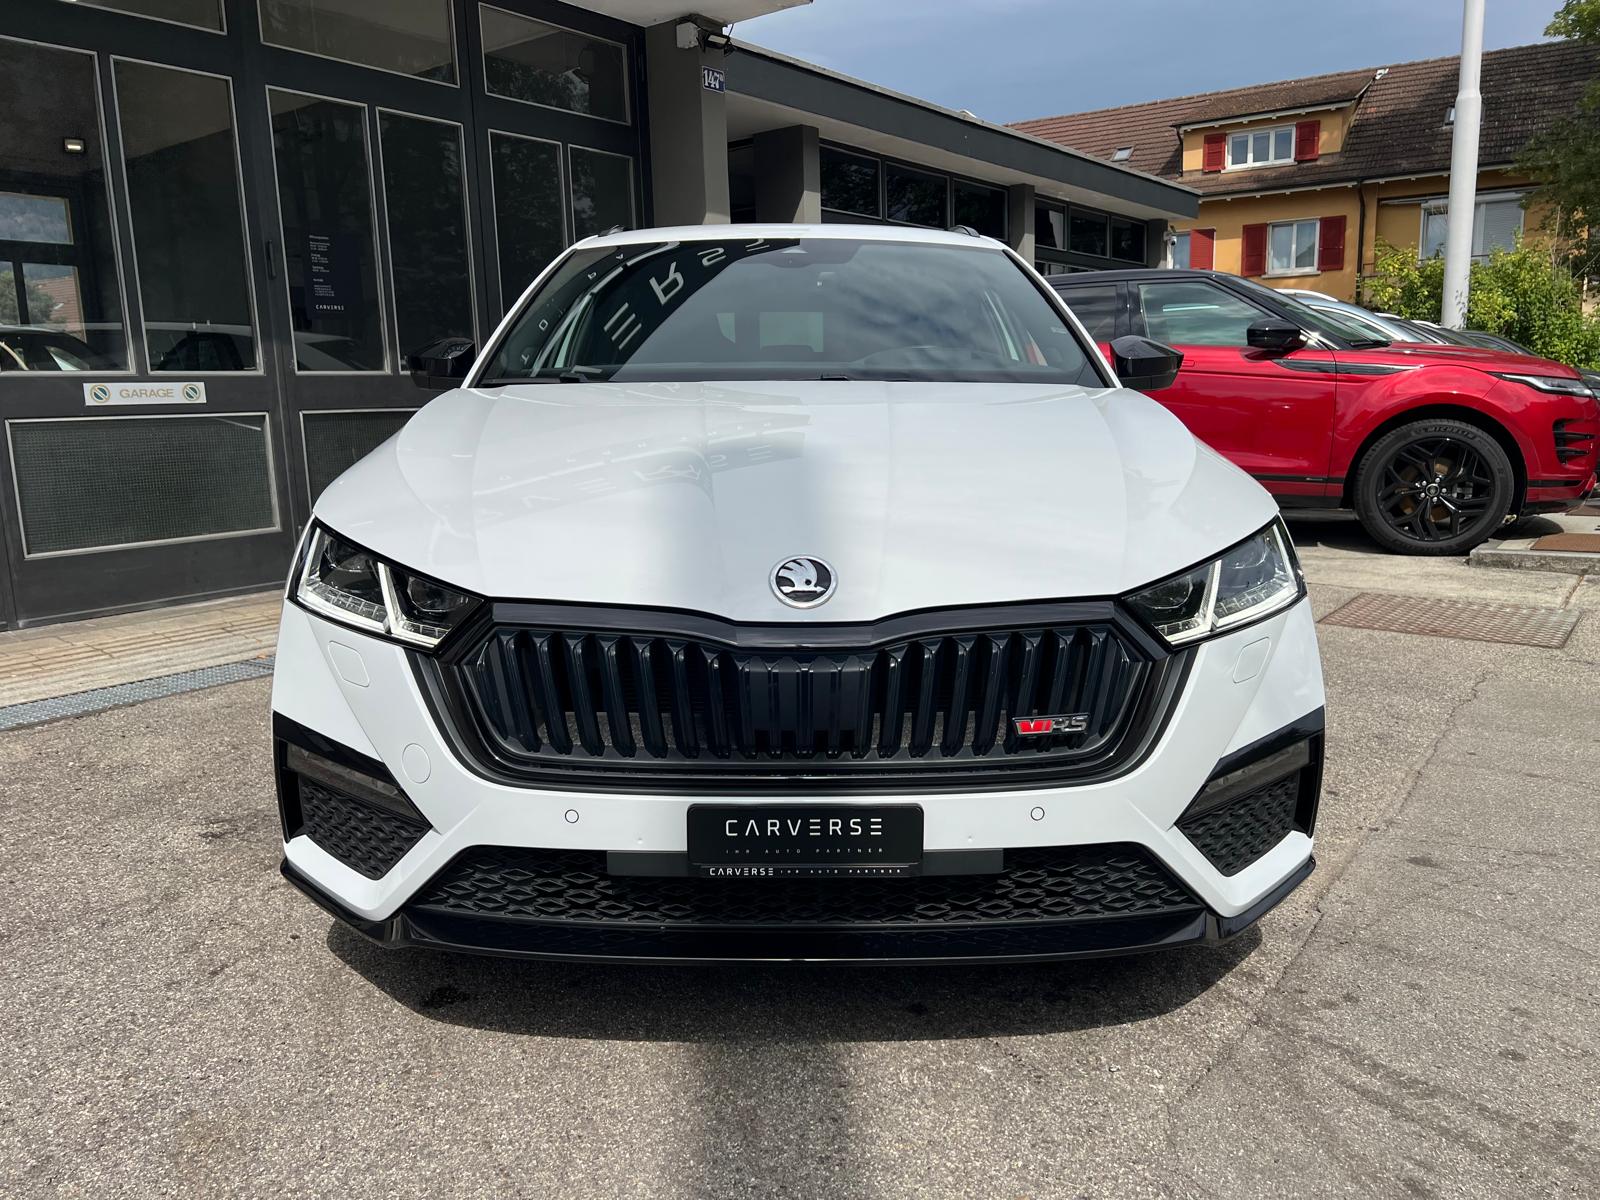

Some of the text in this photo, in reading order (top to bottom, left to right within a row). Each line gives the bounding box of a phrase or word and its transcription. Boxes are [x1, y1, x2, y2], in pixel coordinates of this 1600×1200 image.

[119, 388, 174, 399] GARAGE
[725, 818, 882, 837] CARVERSE
[709, 867, 774, 876] CARVERSE
